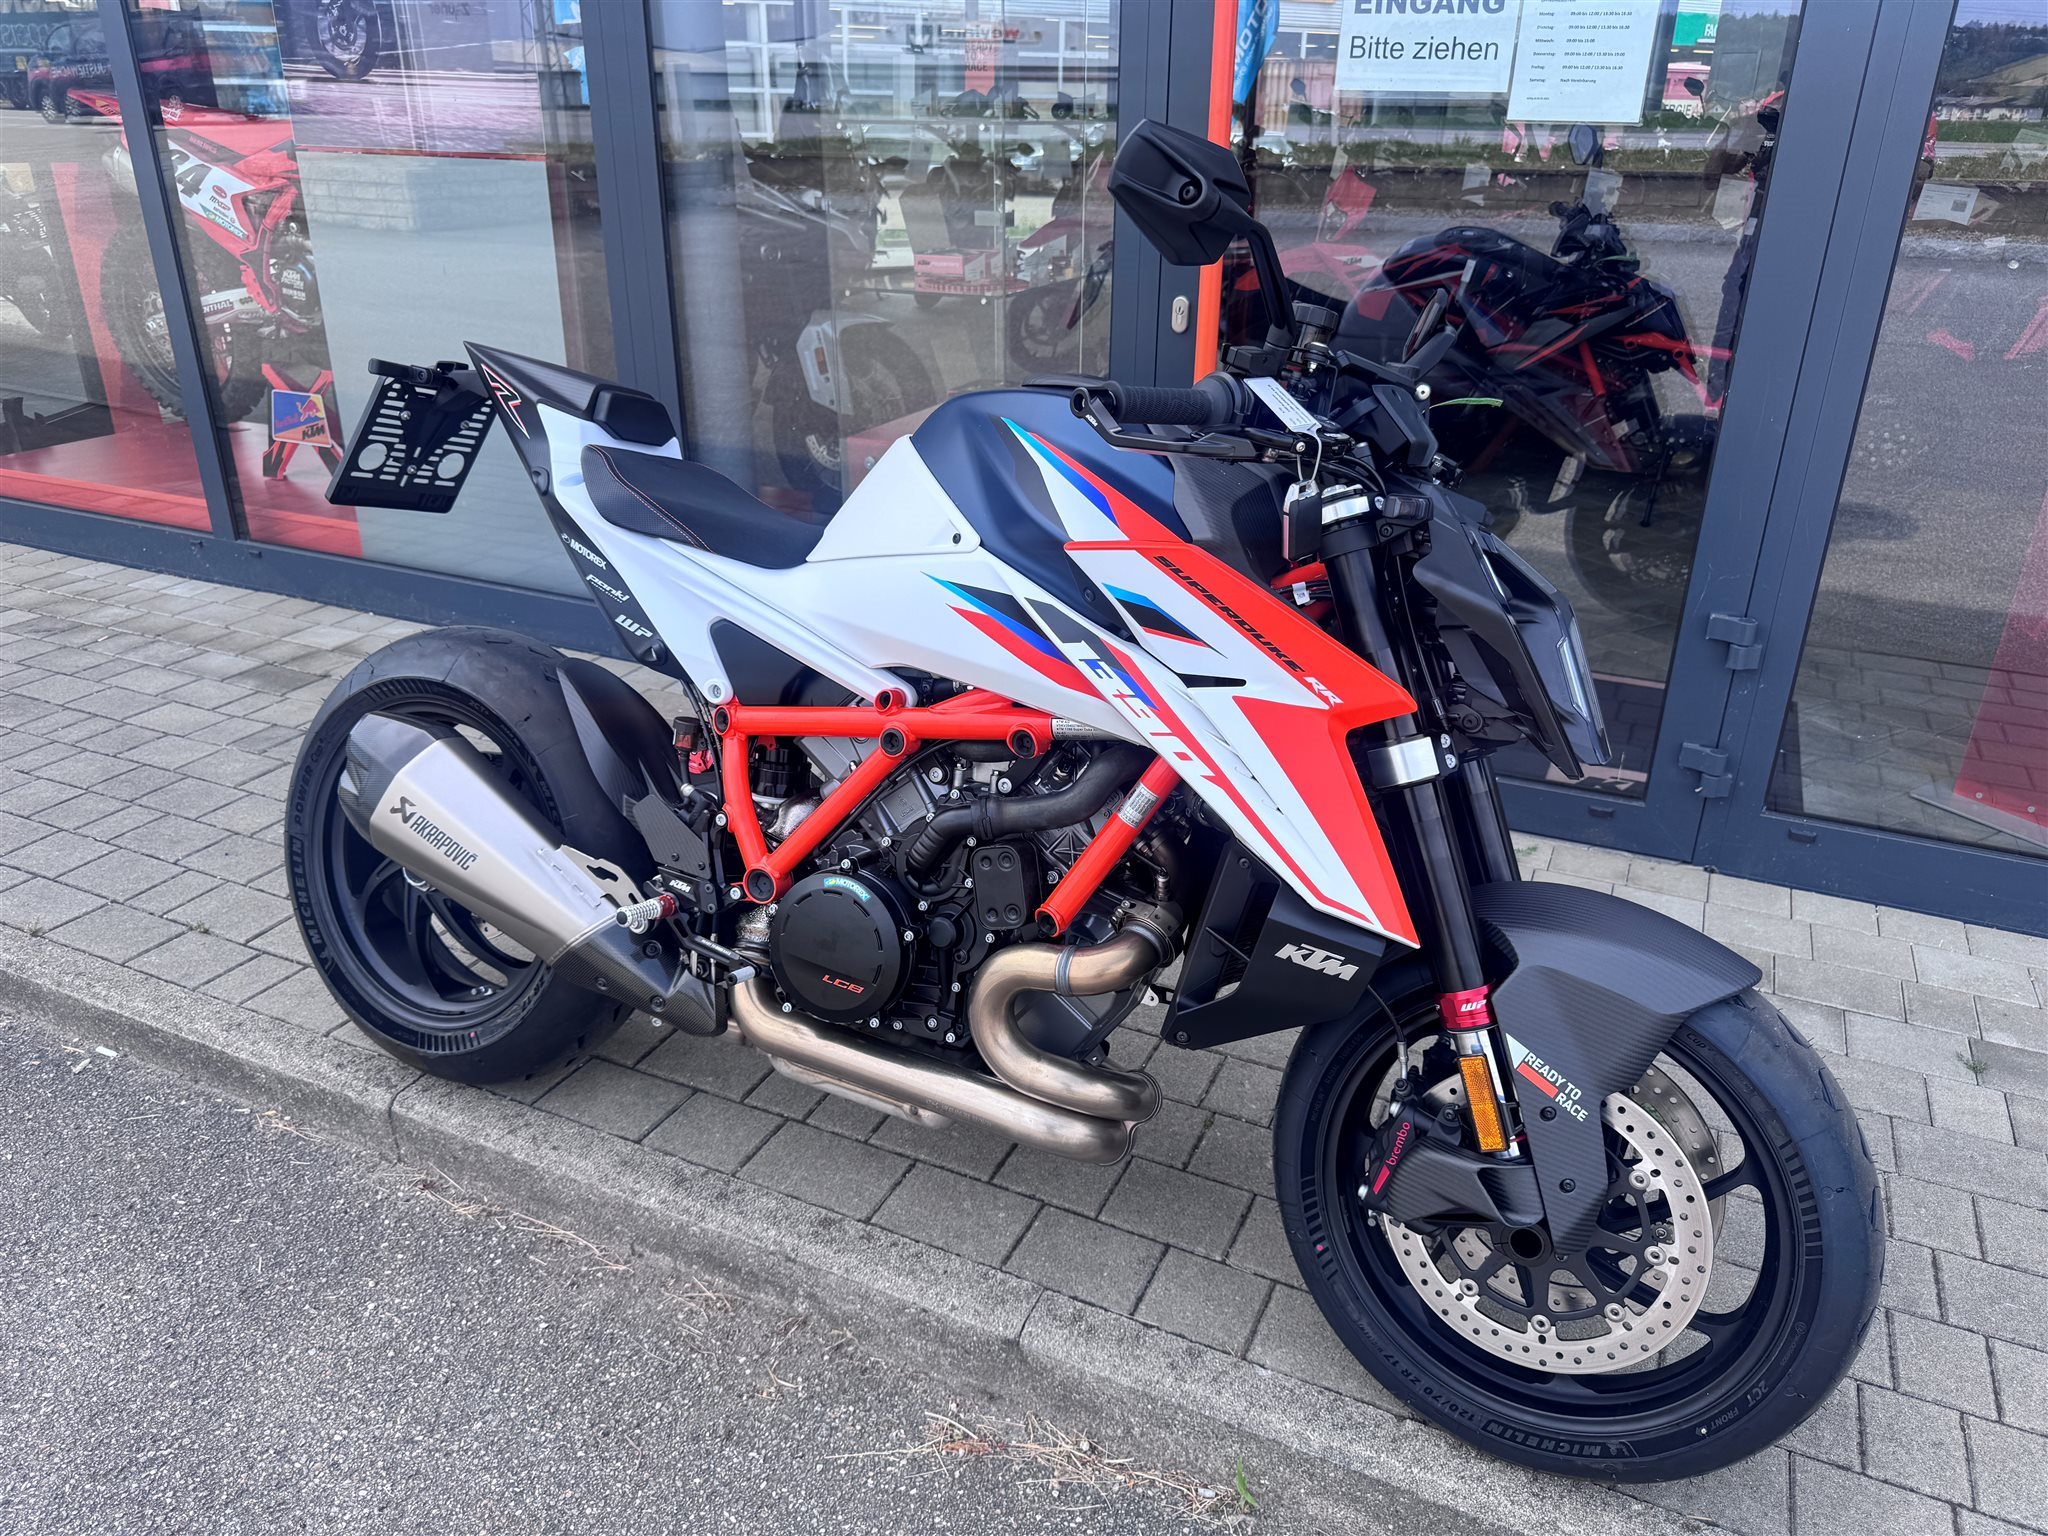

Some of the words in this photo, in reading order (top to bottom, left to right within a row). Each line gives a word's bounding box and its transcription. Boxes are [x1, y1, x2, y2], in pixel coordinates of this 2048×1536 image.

[1349, 35, 1405, 60] Bitte
[1412, 36, 1499, 61] ziehen
[569, 538, 607, 570] MOTOREX
[1303, 677, 1345, 707] RR
[295, 764, 314, 826] POWER
[291, 835, 321, 945] MICHELIN
[669, 879, 691, 893] KTM
[1274, 943, 1359, 981] KTM
[1460, 999, 1487, 1012] WP
[1524, 1052, 1567, 1087] READY
[1562, 1082, 1582, 1101] TO
[1554, 1092, 1589, 1122] RACE
[1385, 1122, 1411, 1165] brembo
[1487, 1422, 1601, 1457] MICHELIN
